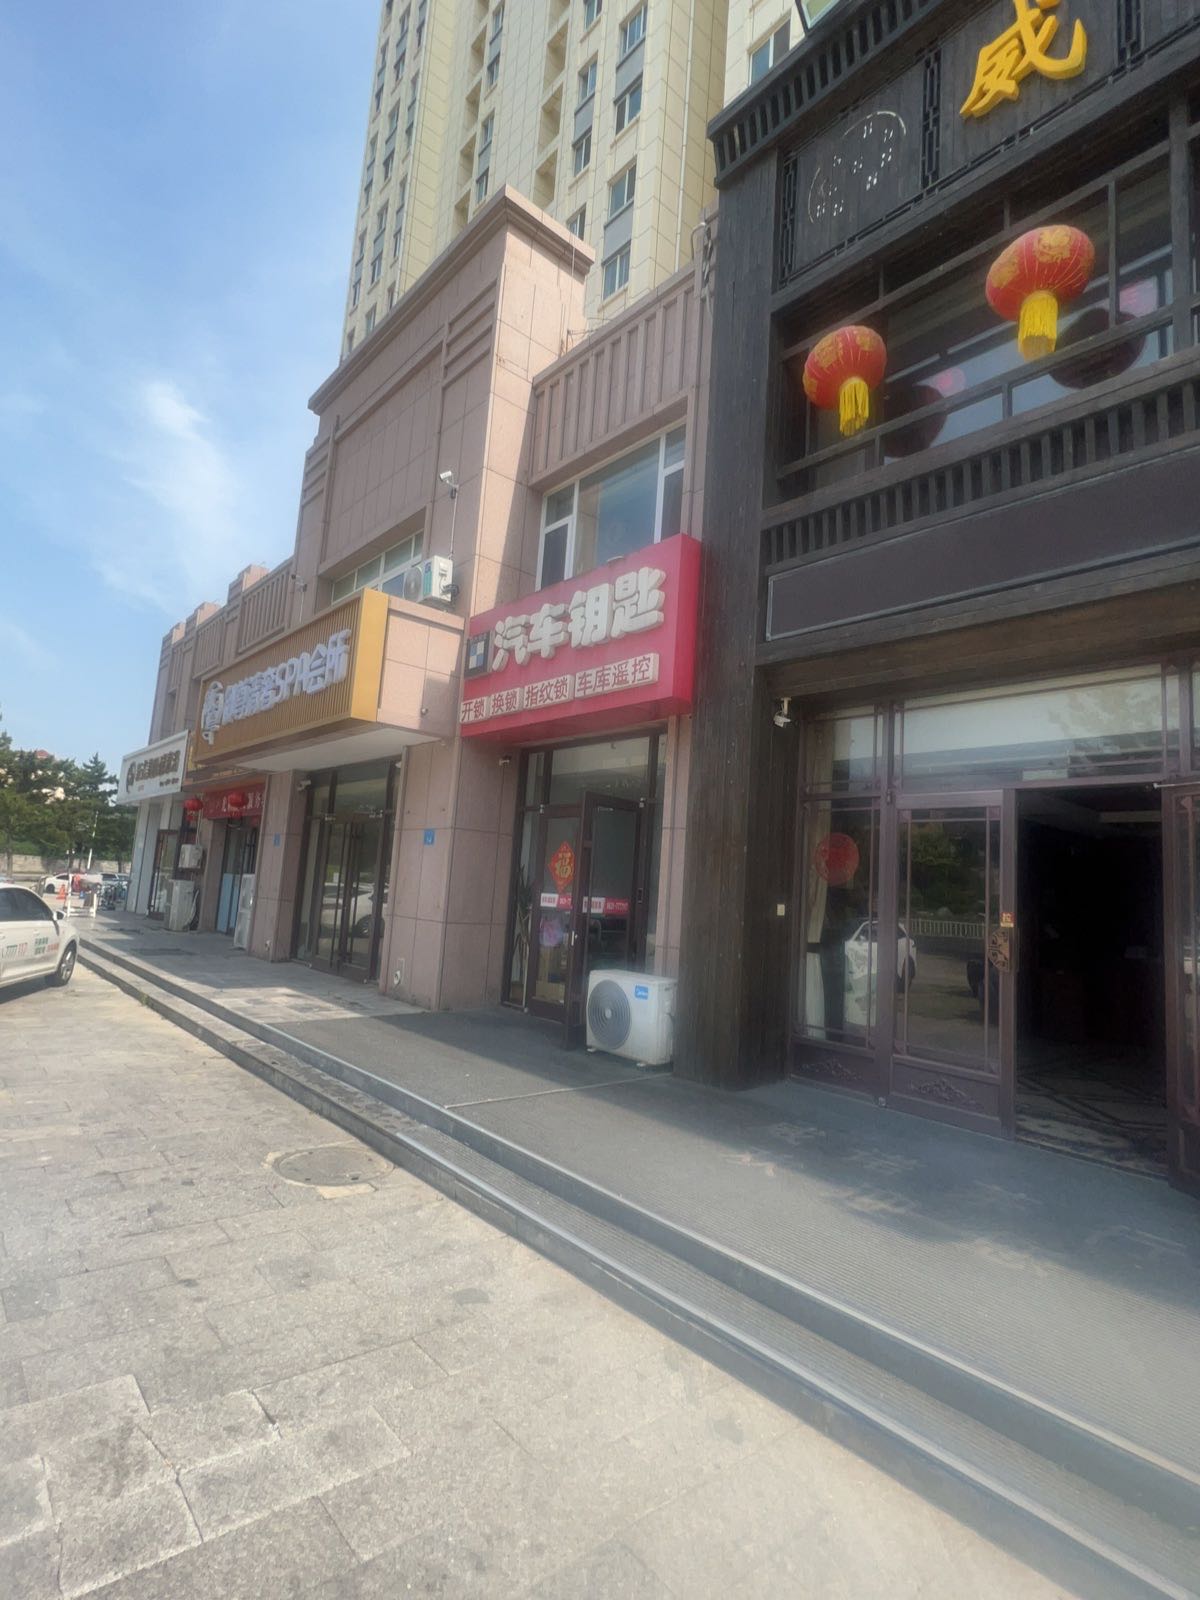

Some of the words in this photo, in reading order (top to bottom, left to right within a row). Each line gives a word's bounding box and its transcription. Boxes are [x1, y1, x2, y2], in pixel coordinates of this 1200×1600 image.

[492, 567, 666, 672] 汽车钥匙
[461, 699, 485, 721] 开锁
[491, 690, 518, 715] 换锁
[525, 676, 569, 707] 指纹锁
[577, 656, 652, 697] 车库遥控
